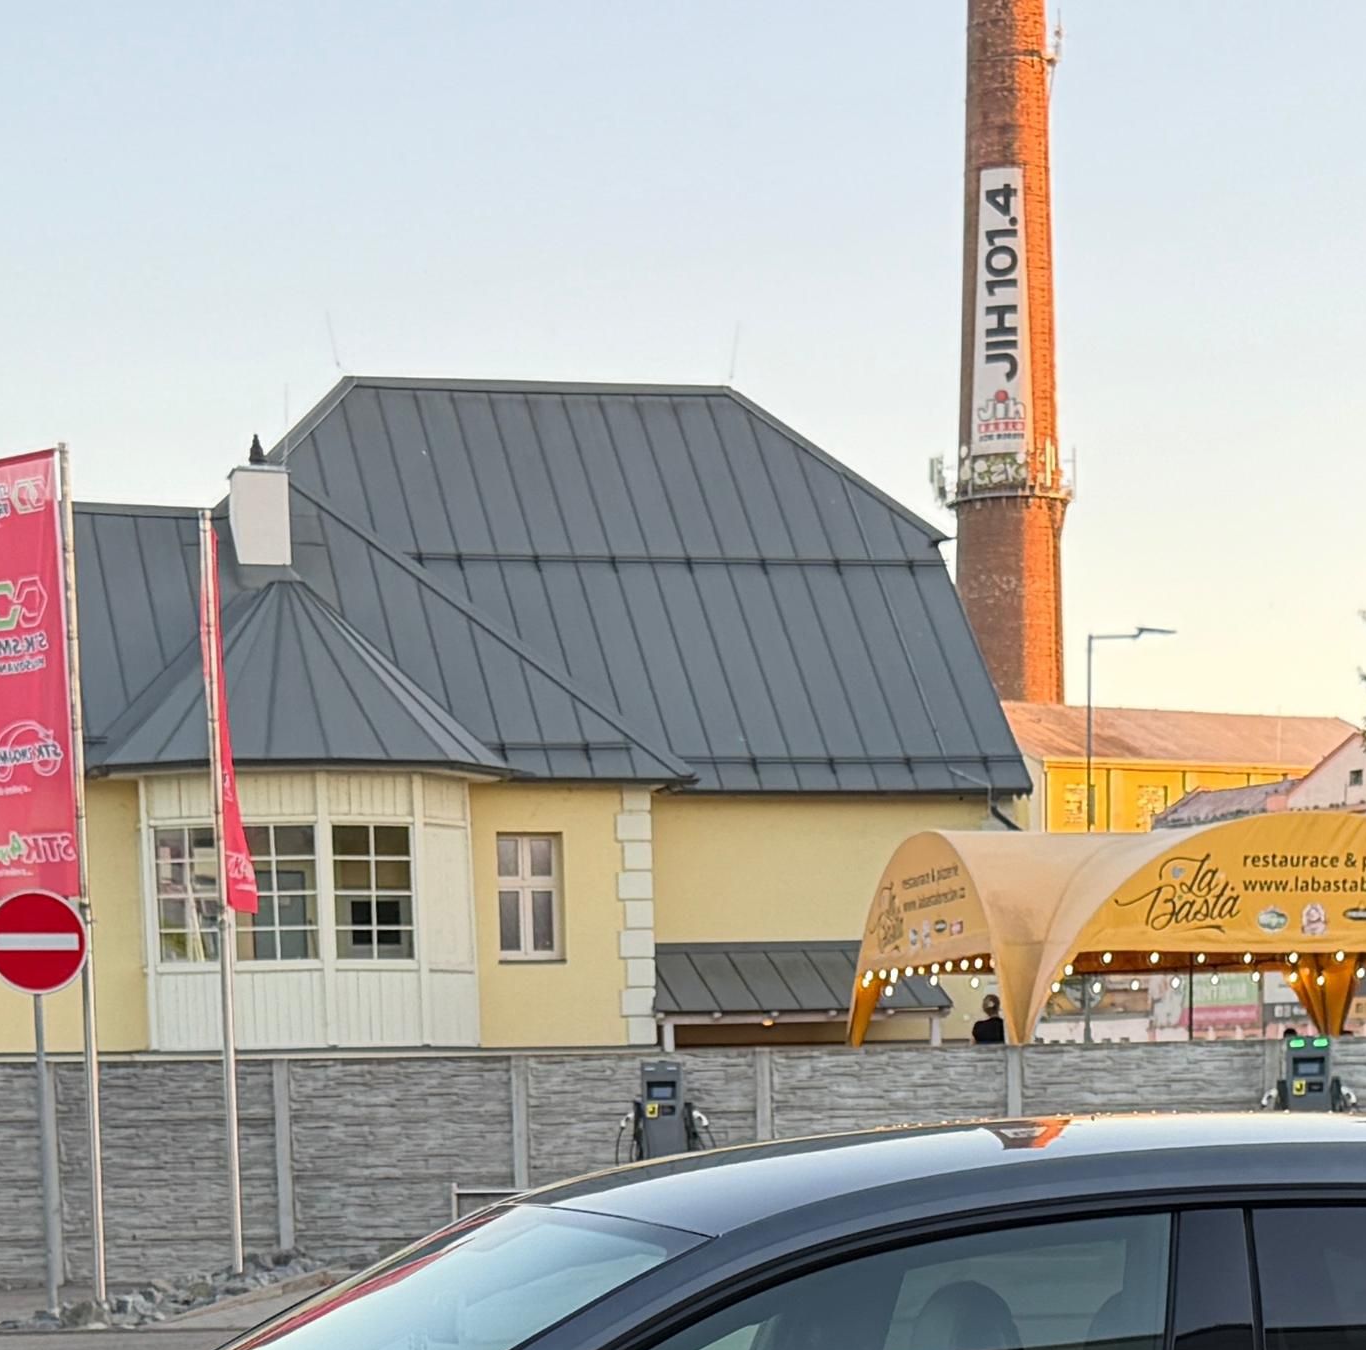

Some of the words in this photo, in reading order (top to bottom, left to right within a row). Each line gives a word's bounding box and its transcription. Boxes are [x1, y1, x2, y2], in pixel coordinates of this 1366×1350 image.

[985, 183, 1018, 297] 101.4
[985, 304, 1018, 383] JIH
[1242, 852, 1340, 868] restaurace
[1344, 852, 1357, 868] &
